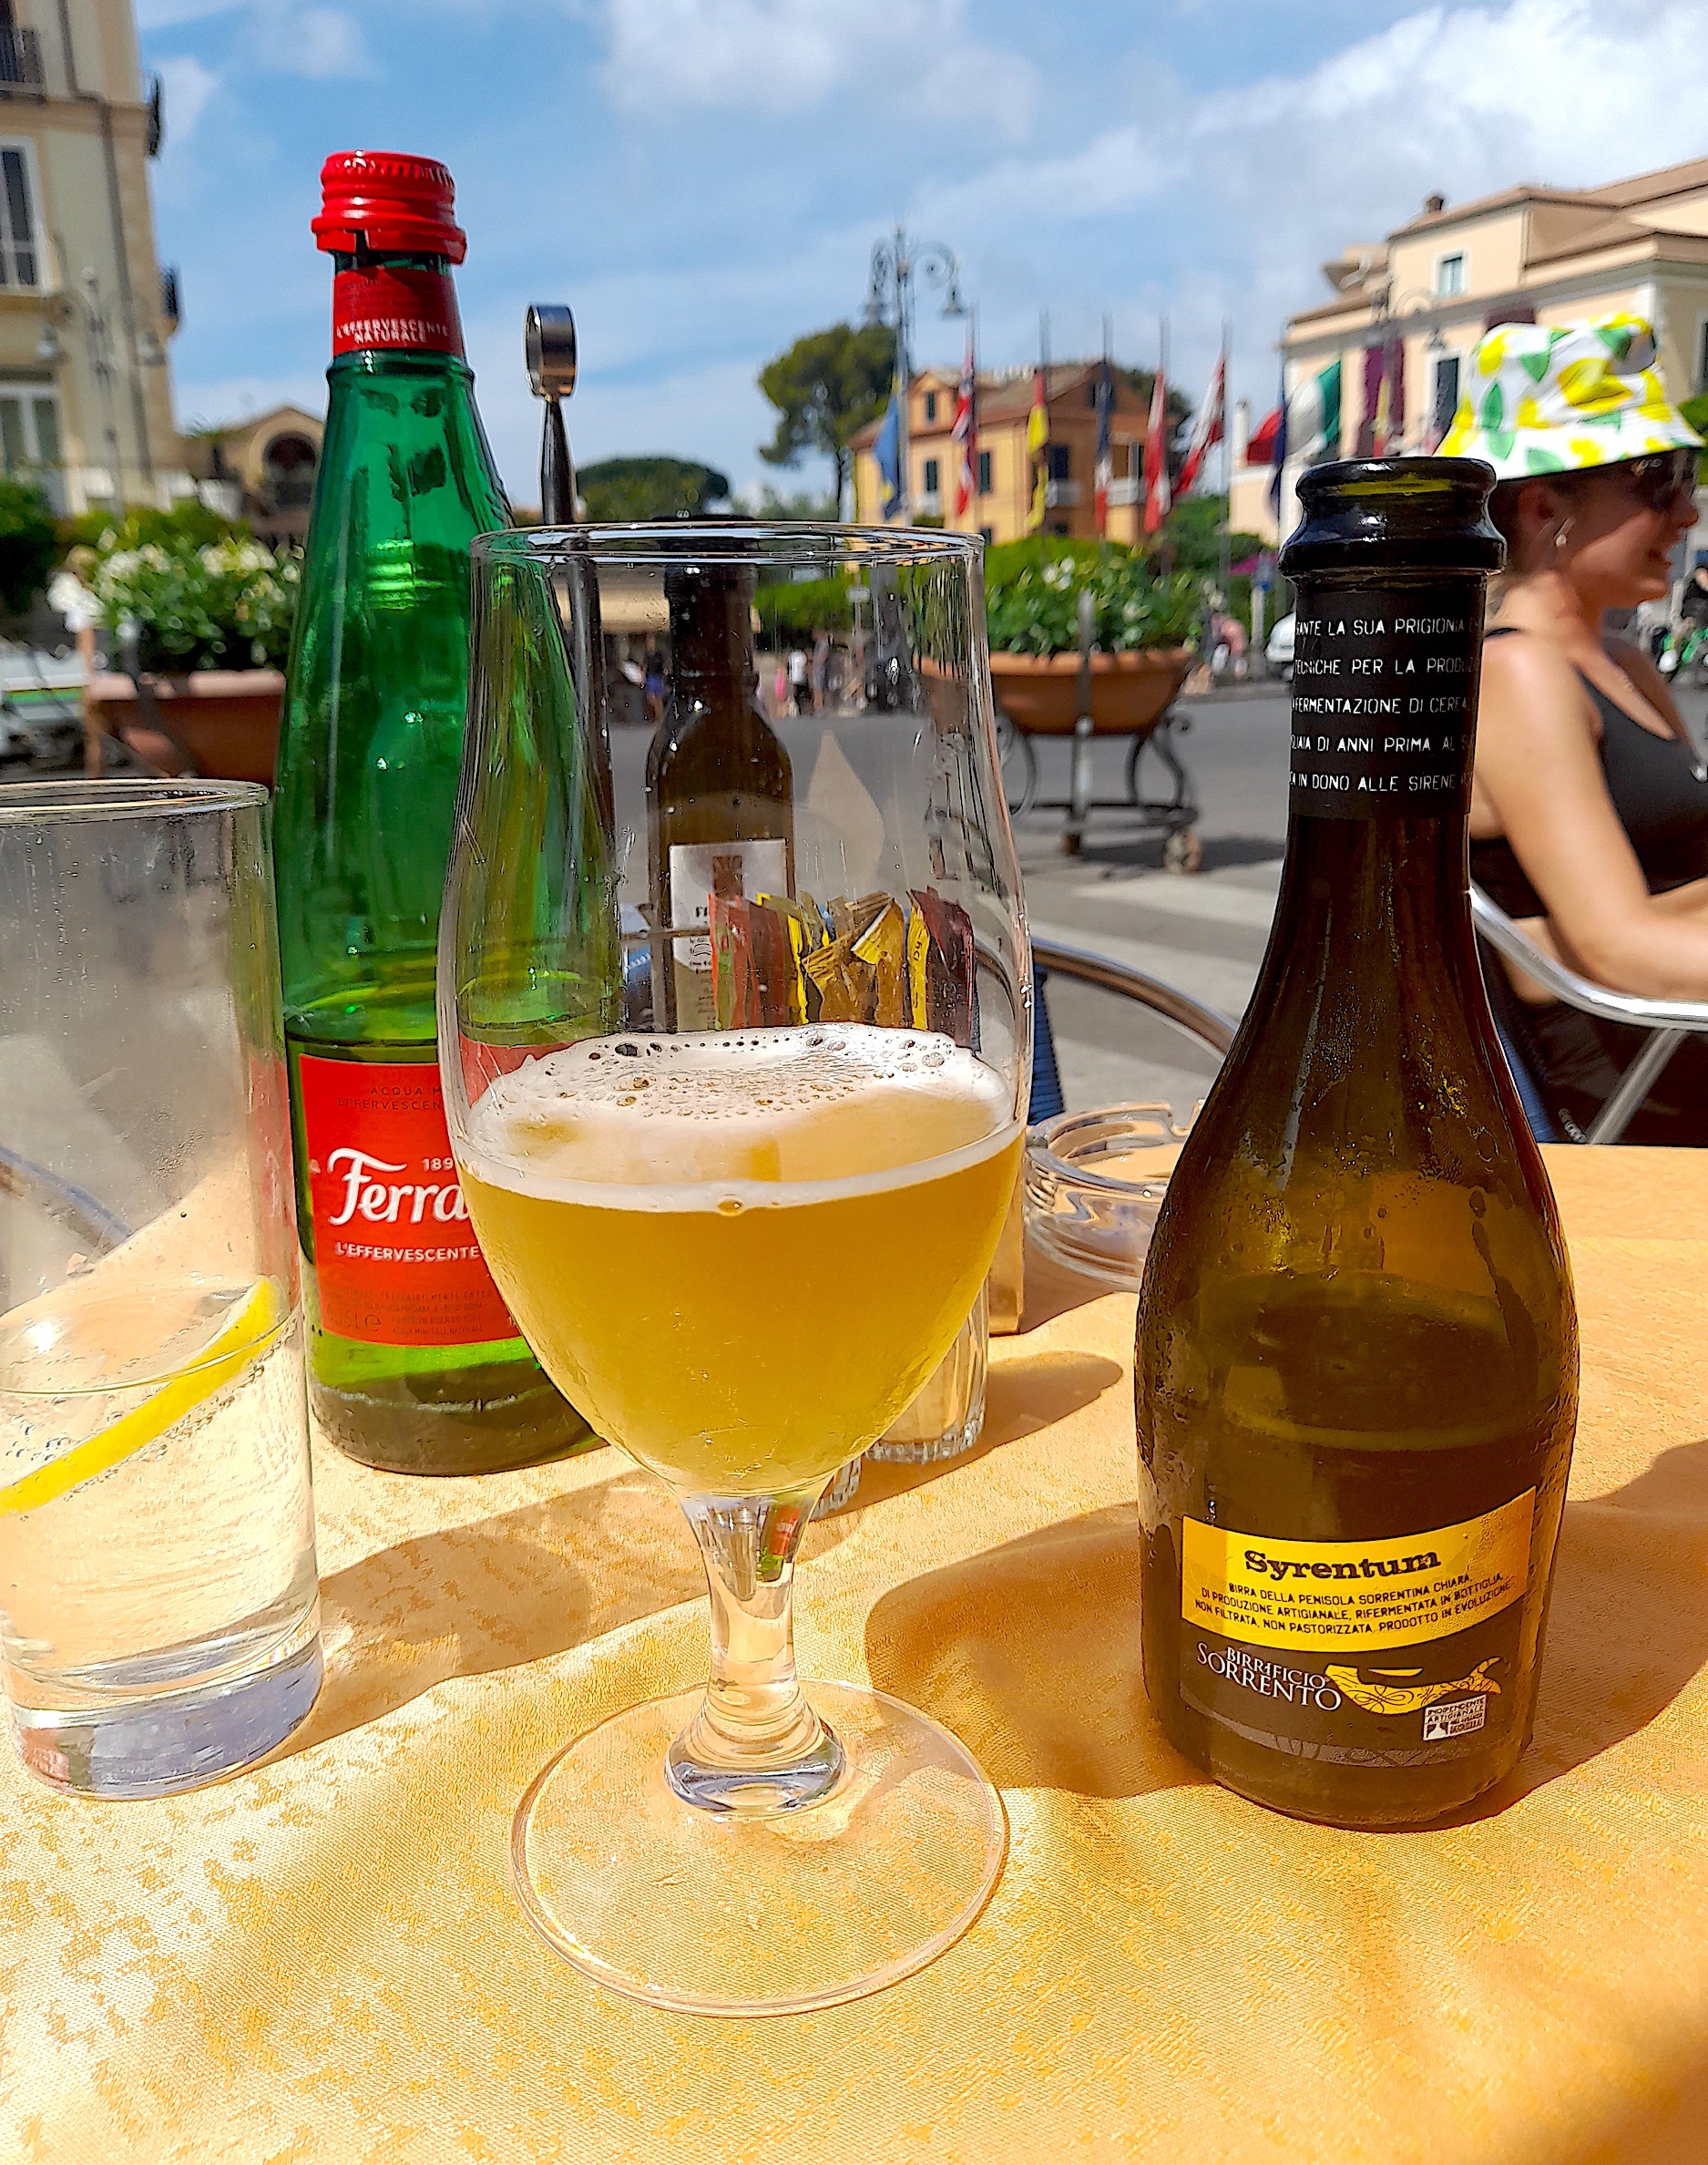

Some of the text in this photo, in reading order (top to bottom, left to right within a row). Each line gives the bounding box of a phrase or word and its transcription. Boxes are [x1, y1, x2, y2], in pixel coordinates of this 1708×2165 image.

[354, 329, 427, 344] NATURALE
[1328, 620, 1345, 636] LA
[1353, 618, 1386, 636] SUA
[1395, 618, 1465, 634] PRIGIONIA
[1294, 658, 1342, 675] TECNICHE
[1351, 658, 1384, 675] PER
[1395, 658, 1416, 675] LA
[1408, 697, 1424, 713] DI
[1317, 736, 1330, 752] DI
[1336, 737, 1374, 753] ANNI
[1384, 736, 1431, 753] PRIMA
[1441, 735, 1456, 751] AL
[1298, 774, 1308, 787] IN
[1312, 774, 1350, 791] DONO
[1357, 775, 1399, 792] ALLE
[1408, 775, 1456, 792] SIRENE
[371, 1086, 424, 1096] ACQUA
[335, 1241, 481, 1263] L'EFFERVESCENTE
[1243, 1549, 1442, 1581] Syrentum
[1228, 1582, 1257, 1597] BIRRA
[1260, 1589, 1295, 1603] DELLA
[1298, 1595, 1355, 1606] PENISOLA
[1358, 1585, 1430, 1606] SORRENTINA
[1201, 1587, 1211, 1599] DI
[1212, 1591, 1274, 1616] PRODUZIONE
[1277, 1606, 1353, 1622] ARTIGIANALE,
[1355, 1596, 1438, 1620] RIFERMENTATA
[1440, 1593, 1451, 1606] IN
[1194, 1598, 1213, 1615] NON
[1263, 1618, 1286, 1632] NON
[1378, 1612, 1439, 1632] PRODOTTO
[1441, 1608, 1453, 1619] IN
[1196, 1642, 1343, 1711] SORRENTO
[1226, 1646, 1326, 1689] BIRRIFICIO
